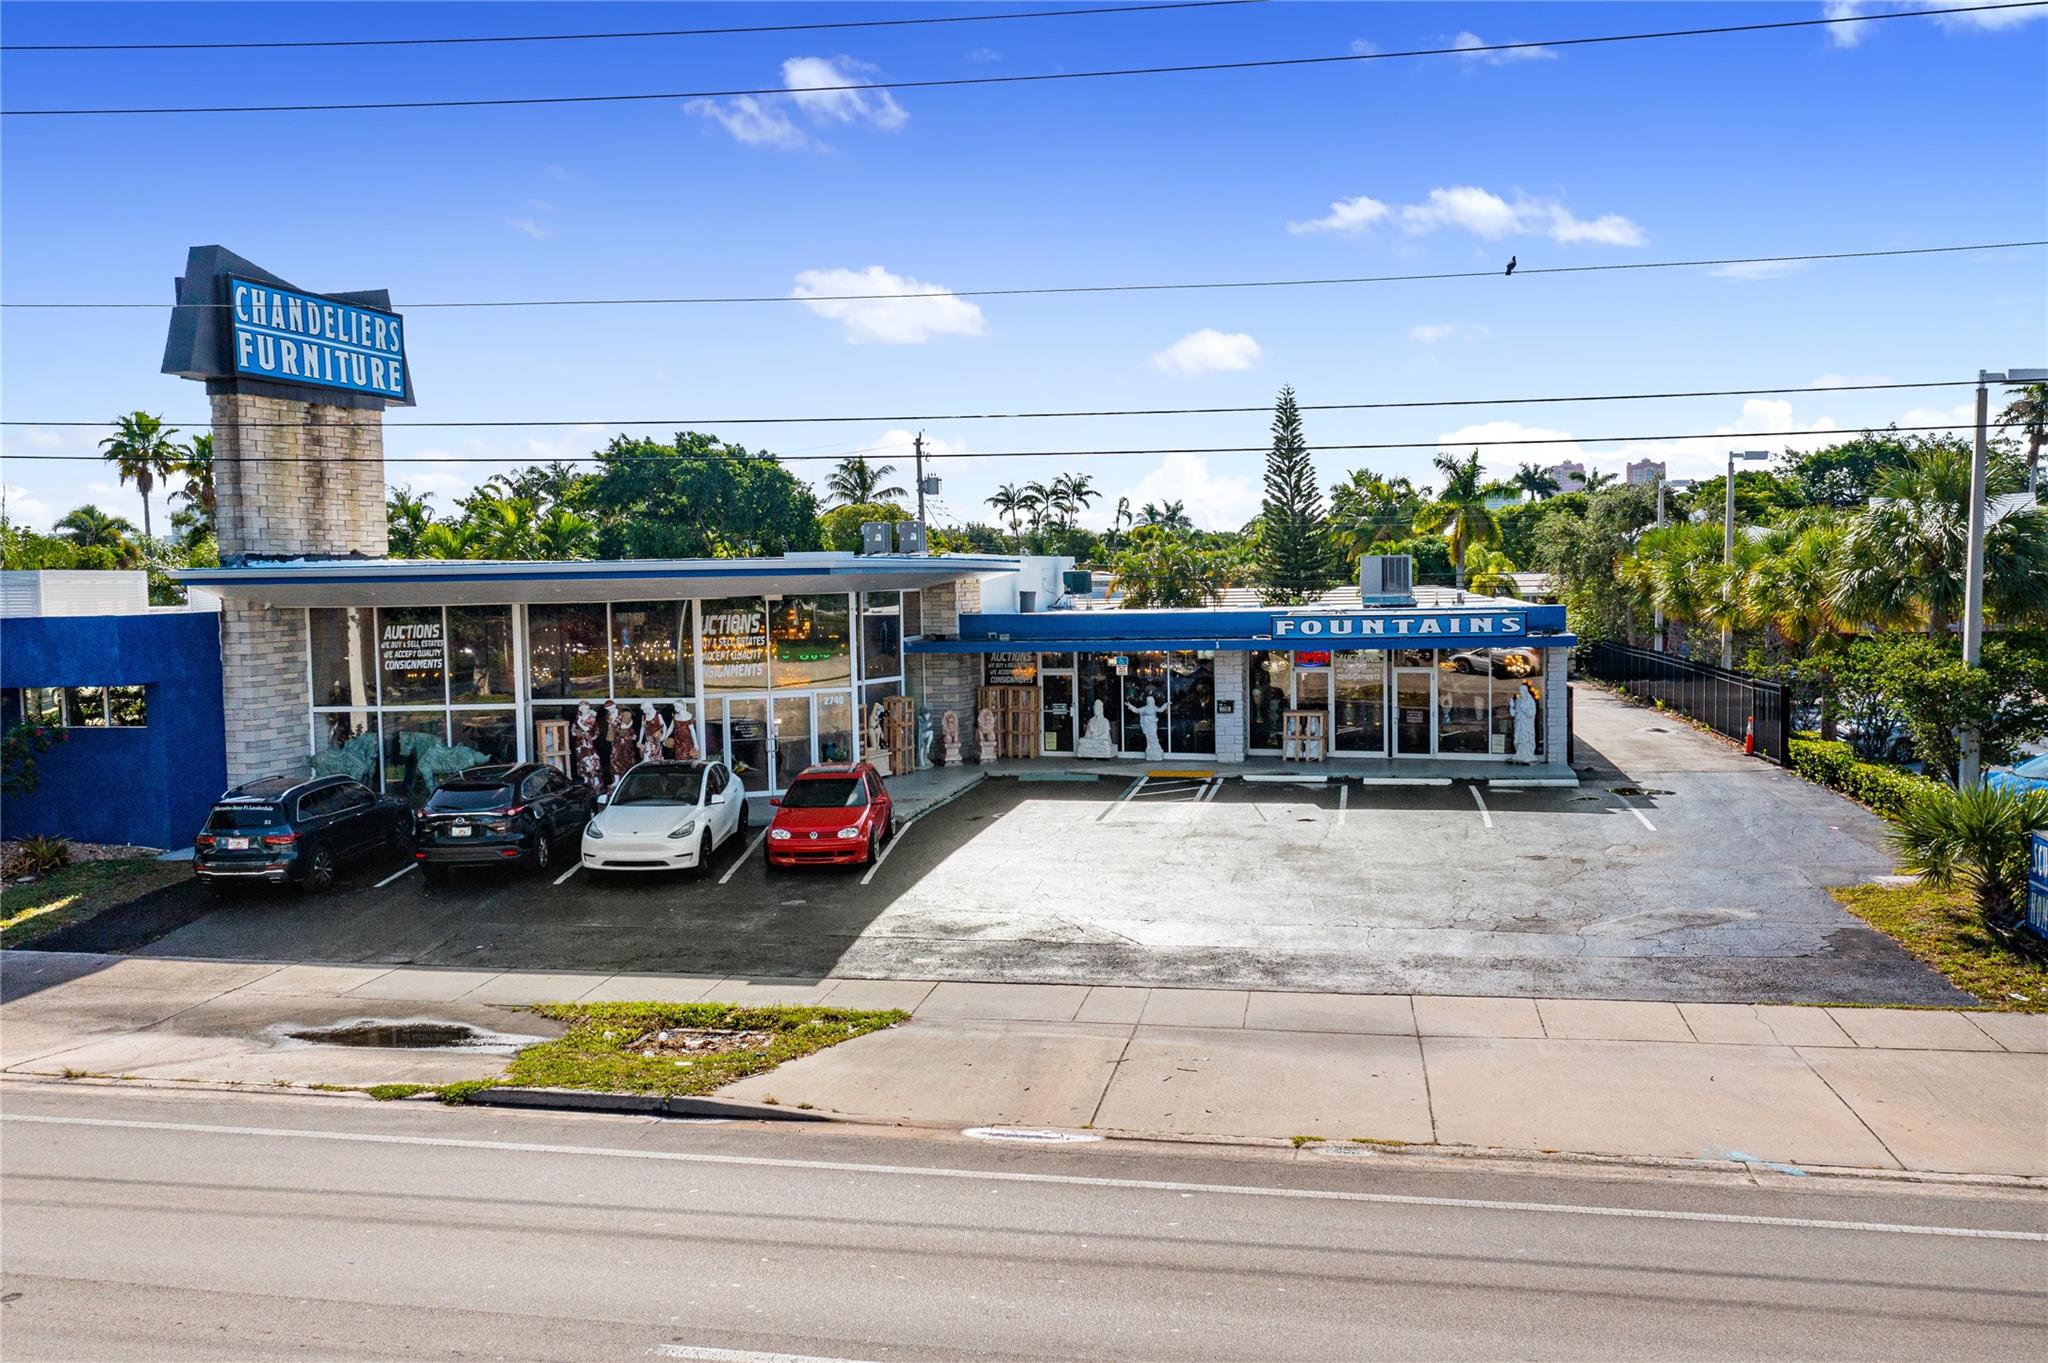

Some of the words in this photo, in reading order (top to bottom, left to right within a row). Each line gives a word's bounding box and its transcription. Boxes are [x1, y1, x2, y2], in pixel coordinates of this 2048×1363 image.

[235, 285, 400, 353] CHANDELIERS
[237, 330, 401, 392] FURNITURE
[383, 623, 440, 640] AUCTIONS
[701, 613, 761, 635] UCTIONS
[1275, 617, 1521, 635] FOUNTAINS
[407, 640, 420, 648] SELL
[421, 639, 444, 647] ESTATES
[394, 650, 417, 658] ACCEPT
[417, 649, 442, 657] QUALITY
[1295, 652, 1331, 663] OPEN
[385, 658, 443, 670] CONSIGNMENTS
[703, 662, 763, 678] NSIGNMENTS
[824, 695, 844, 705] 2740
